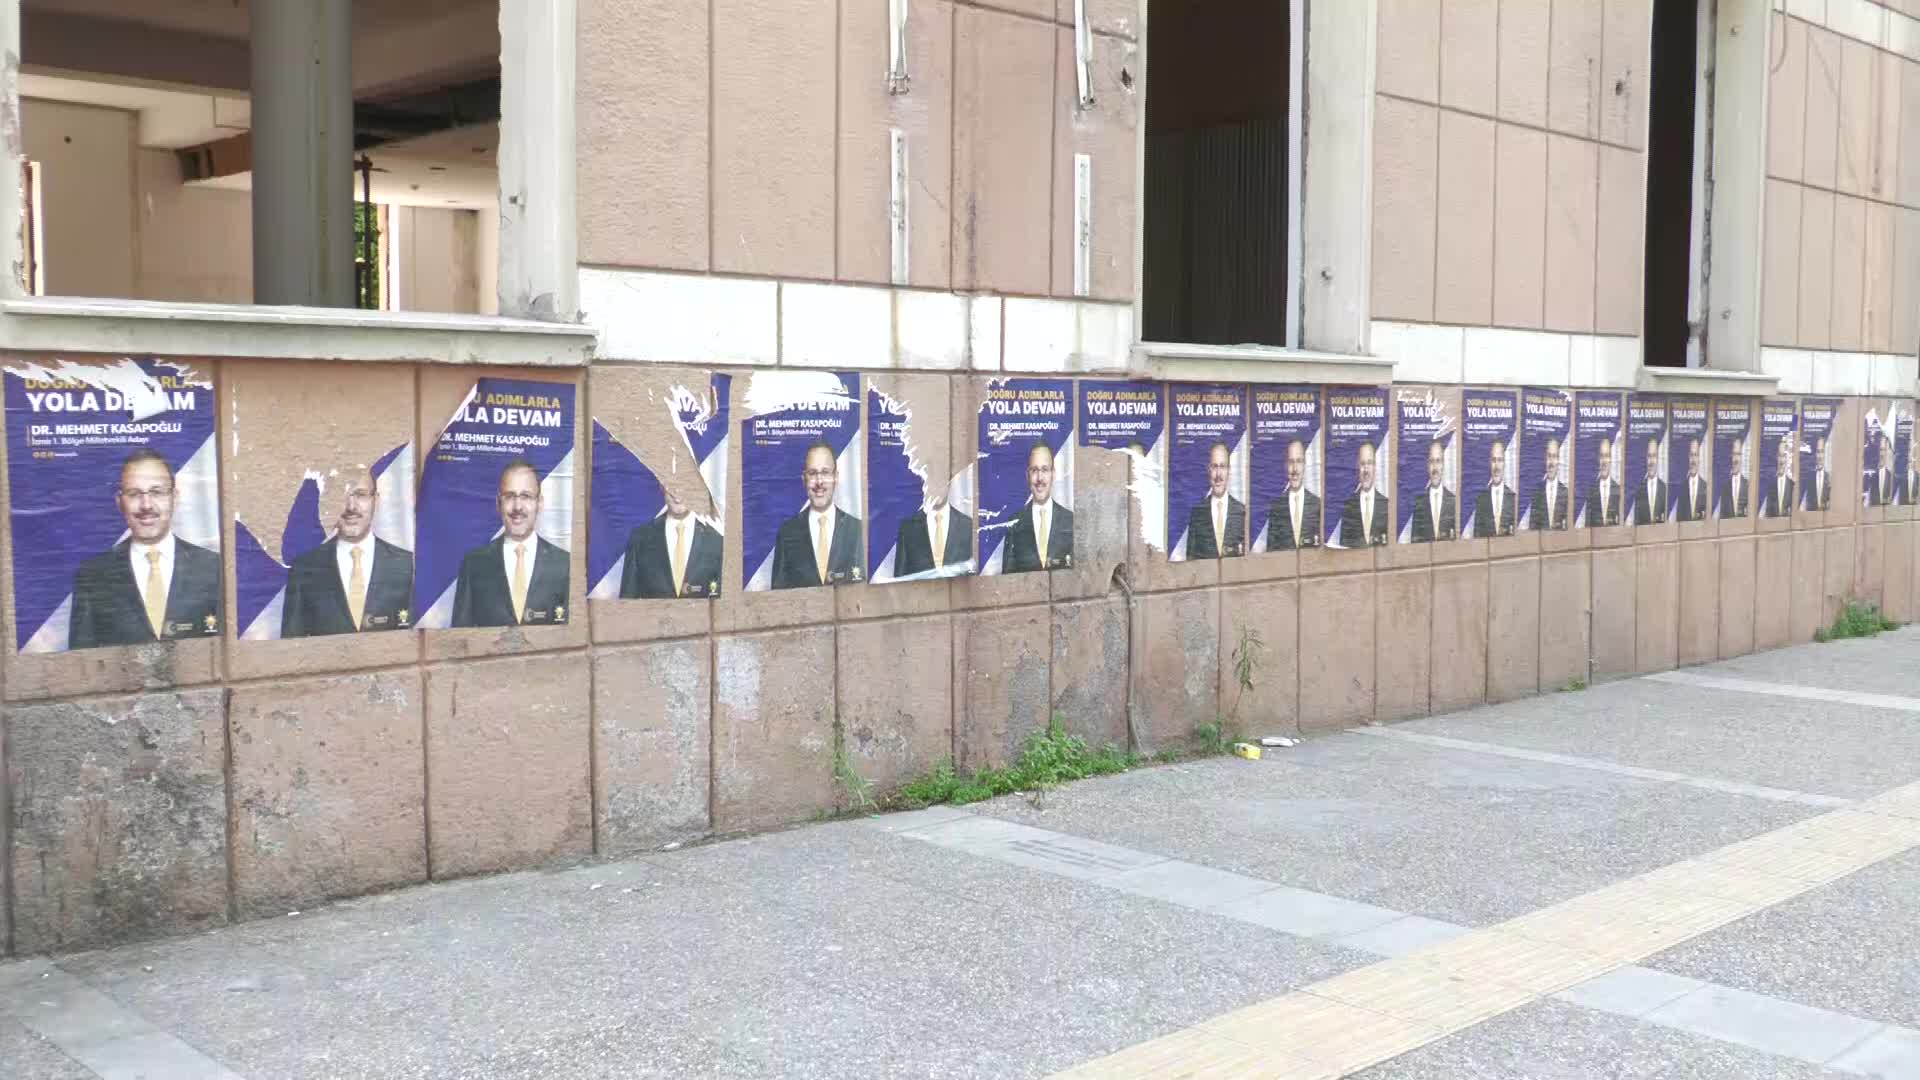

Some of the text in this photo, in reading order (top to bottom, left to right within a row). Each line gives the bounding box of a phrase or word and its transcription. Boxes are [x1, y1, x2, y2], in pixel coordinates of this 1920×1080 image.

[988, 389, 1065, 400] DOĞRU ADIMLARLA
[1087, 390, 1157, 400] DOĞRU ADIMLARLA
[25, 391, 195, 412] YOLA DEM
[486, 393, 560, 409] ADIMLARLA
[988, 400, 1066, 415] YOLA DEVAM
[1087, 402, 1157, 415] YOLA DEVAM
[1176, 404, 1240, 416] YOLA DEVAM
[1256, 402, 1315, 414] YOLA DEVAM
[1331, 406, 1385, 418] YOLA DEVAM
[1403, 406, 1424, 418] YOLA
[1467, 406, 1513, 418] YOLA DEVAM
[1526, 402, 1544, 414] YOLA
[493, 407, 560, 427] DEVAM
[31, 421, 182, 435] DR. MEHMET KASAPOĞLU
[768, 419, 800, 428] MEHMET
[454, 432, 495, 443] MEHMET
[496, 434, 549, 446] KASAPOĞLU
